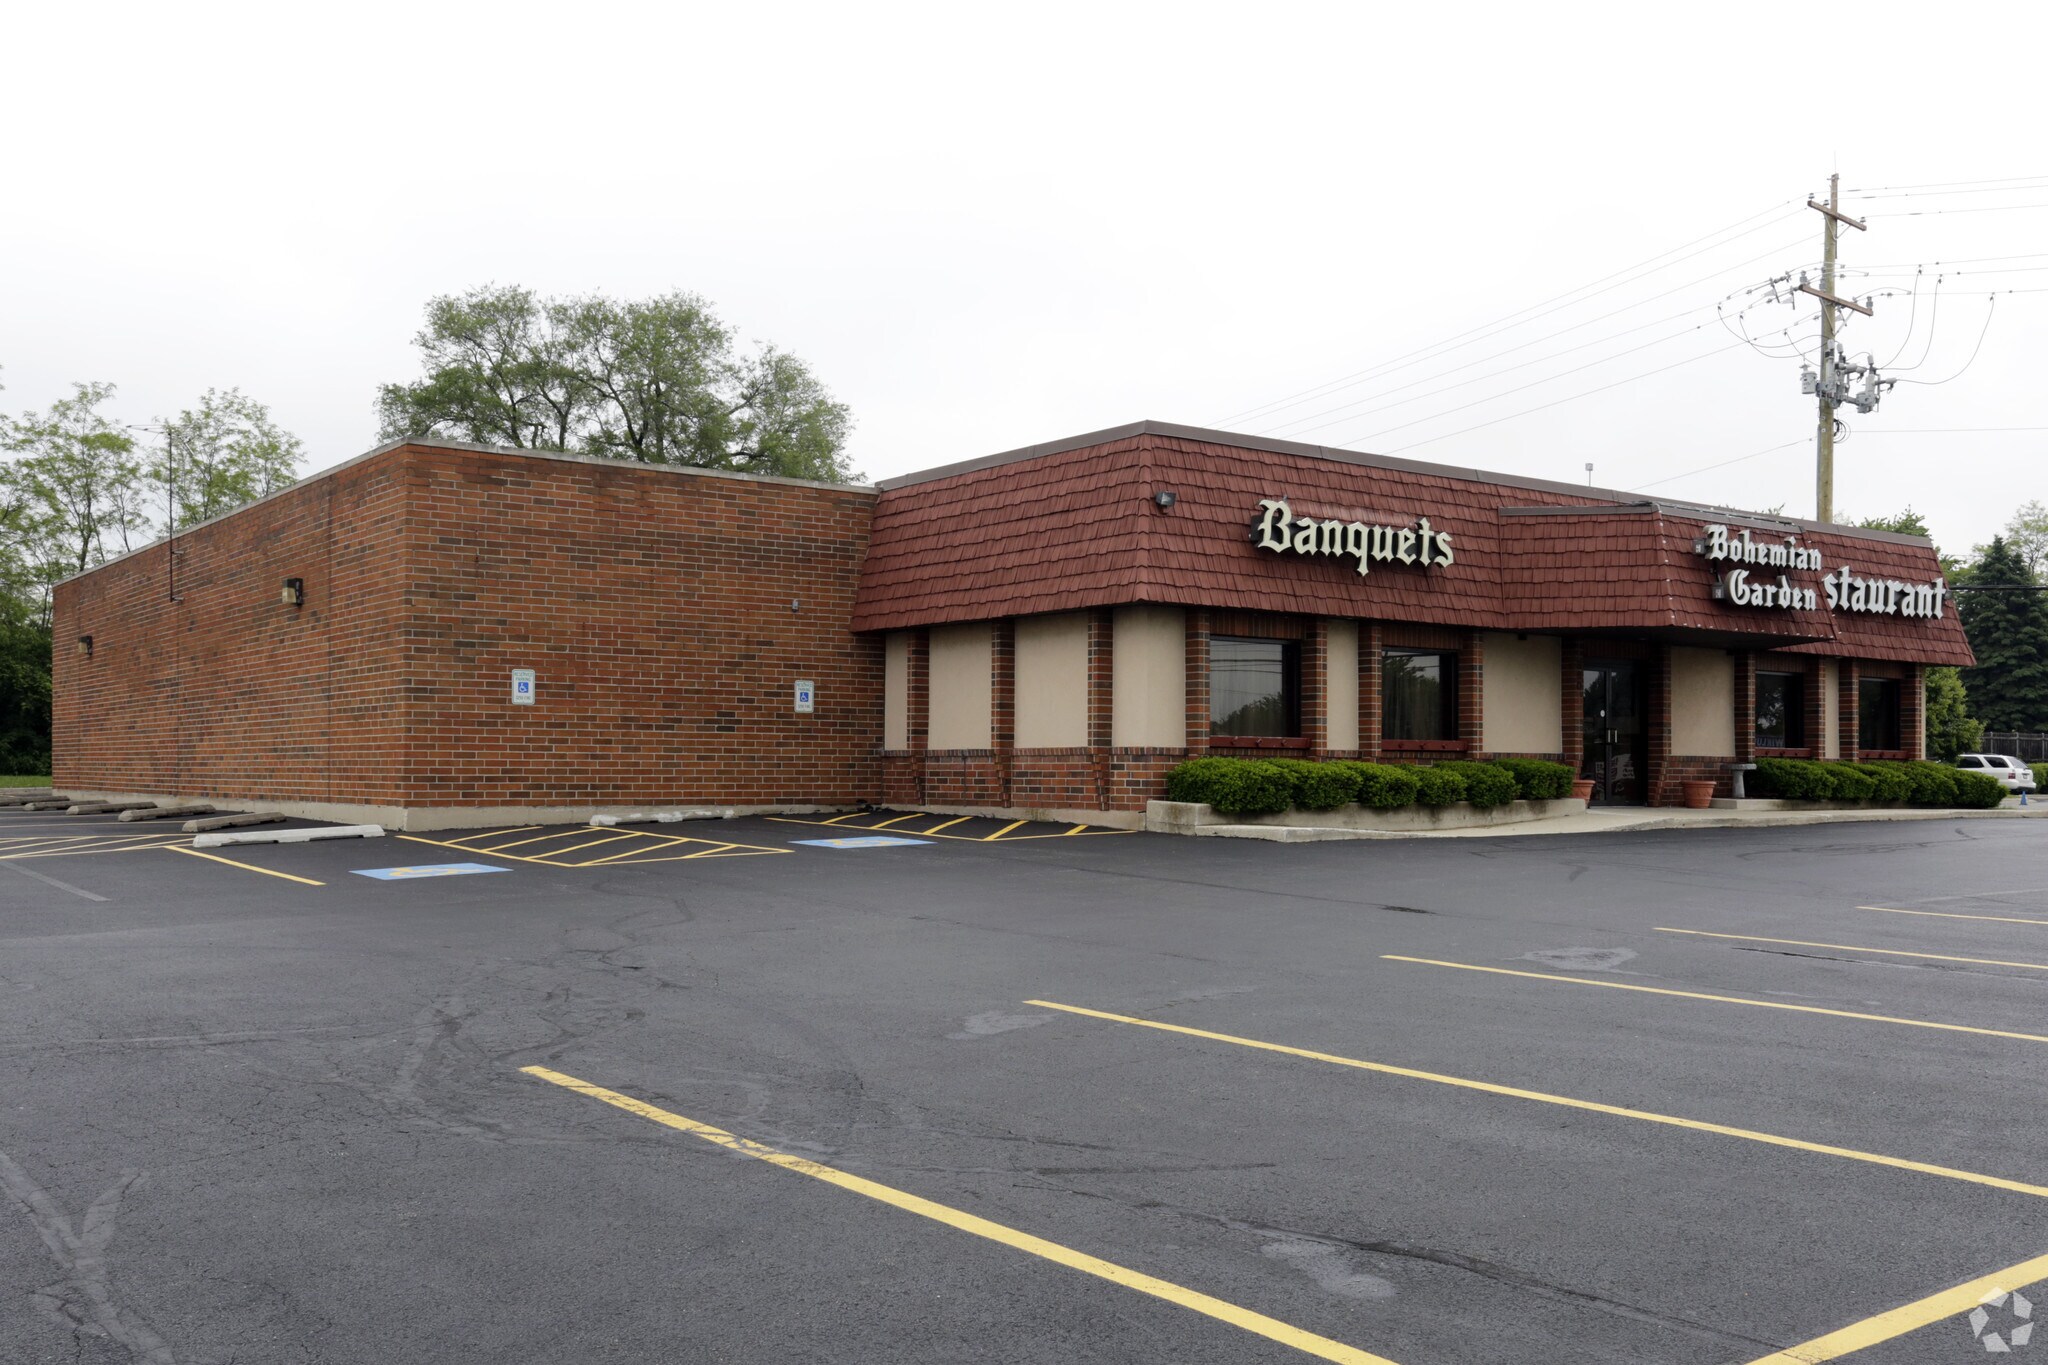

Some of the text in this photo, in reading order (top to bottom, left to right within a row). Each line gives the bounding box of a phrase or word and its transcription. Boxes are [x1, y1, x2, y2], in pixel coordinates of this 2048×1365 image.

[1257, 499, 1454, 577] Banquets
[1703, 524, 1822, 571] Bohemian
[1727, 569, 1817, 611] Garden
[1821, 565, 1947, 620] staurant
